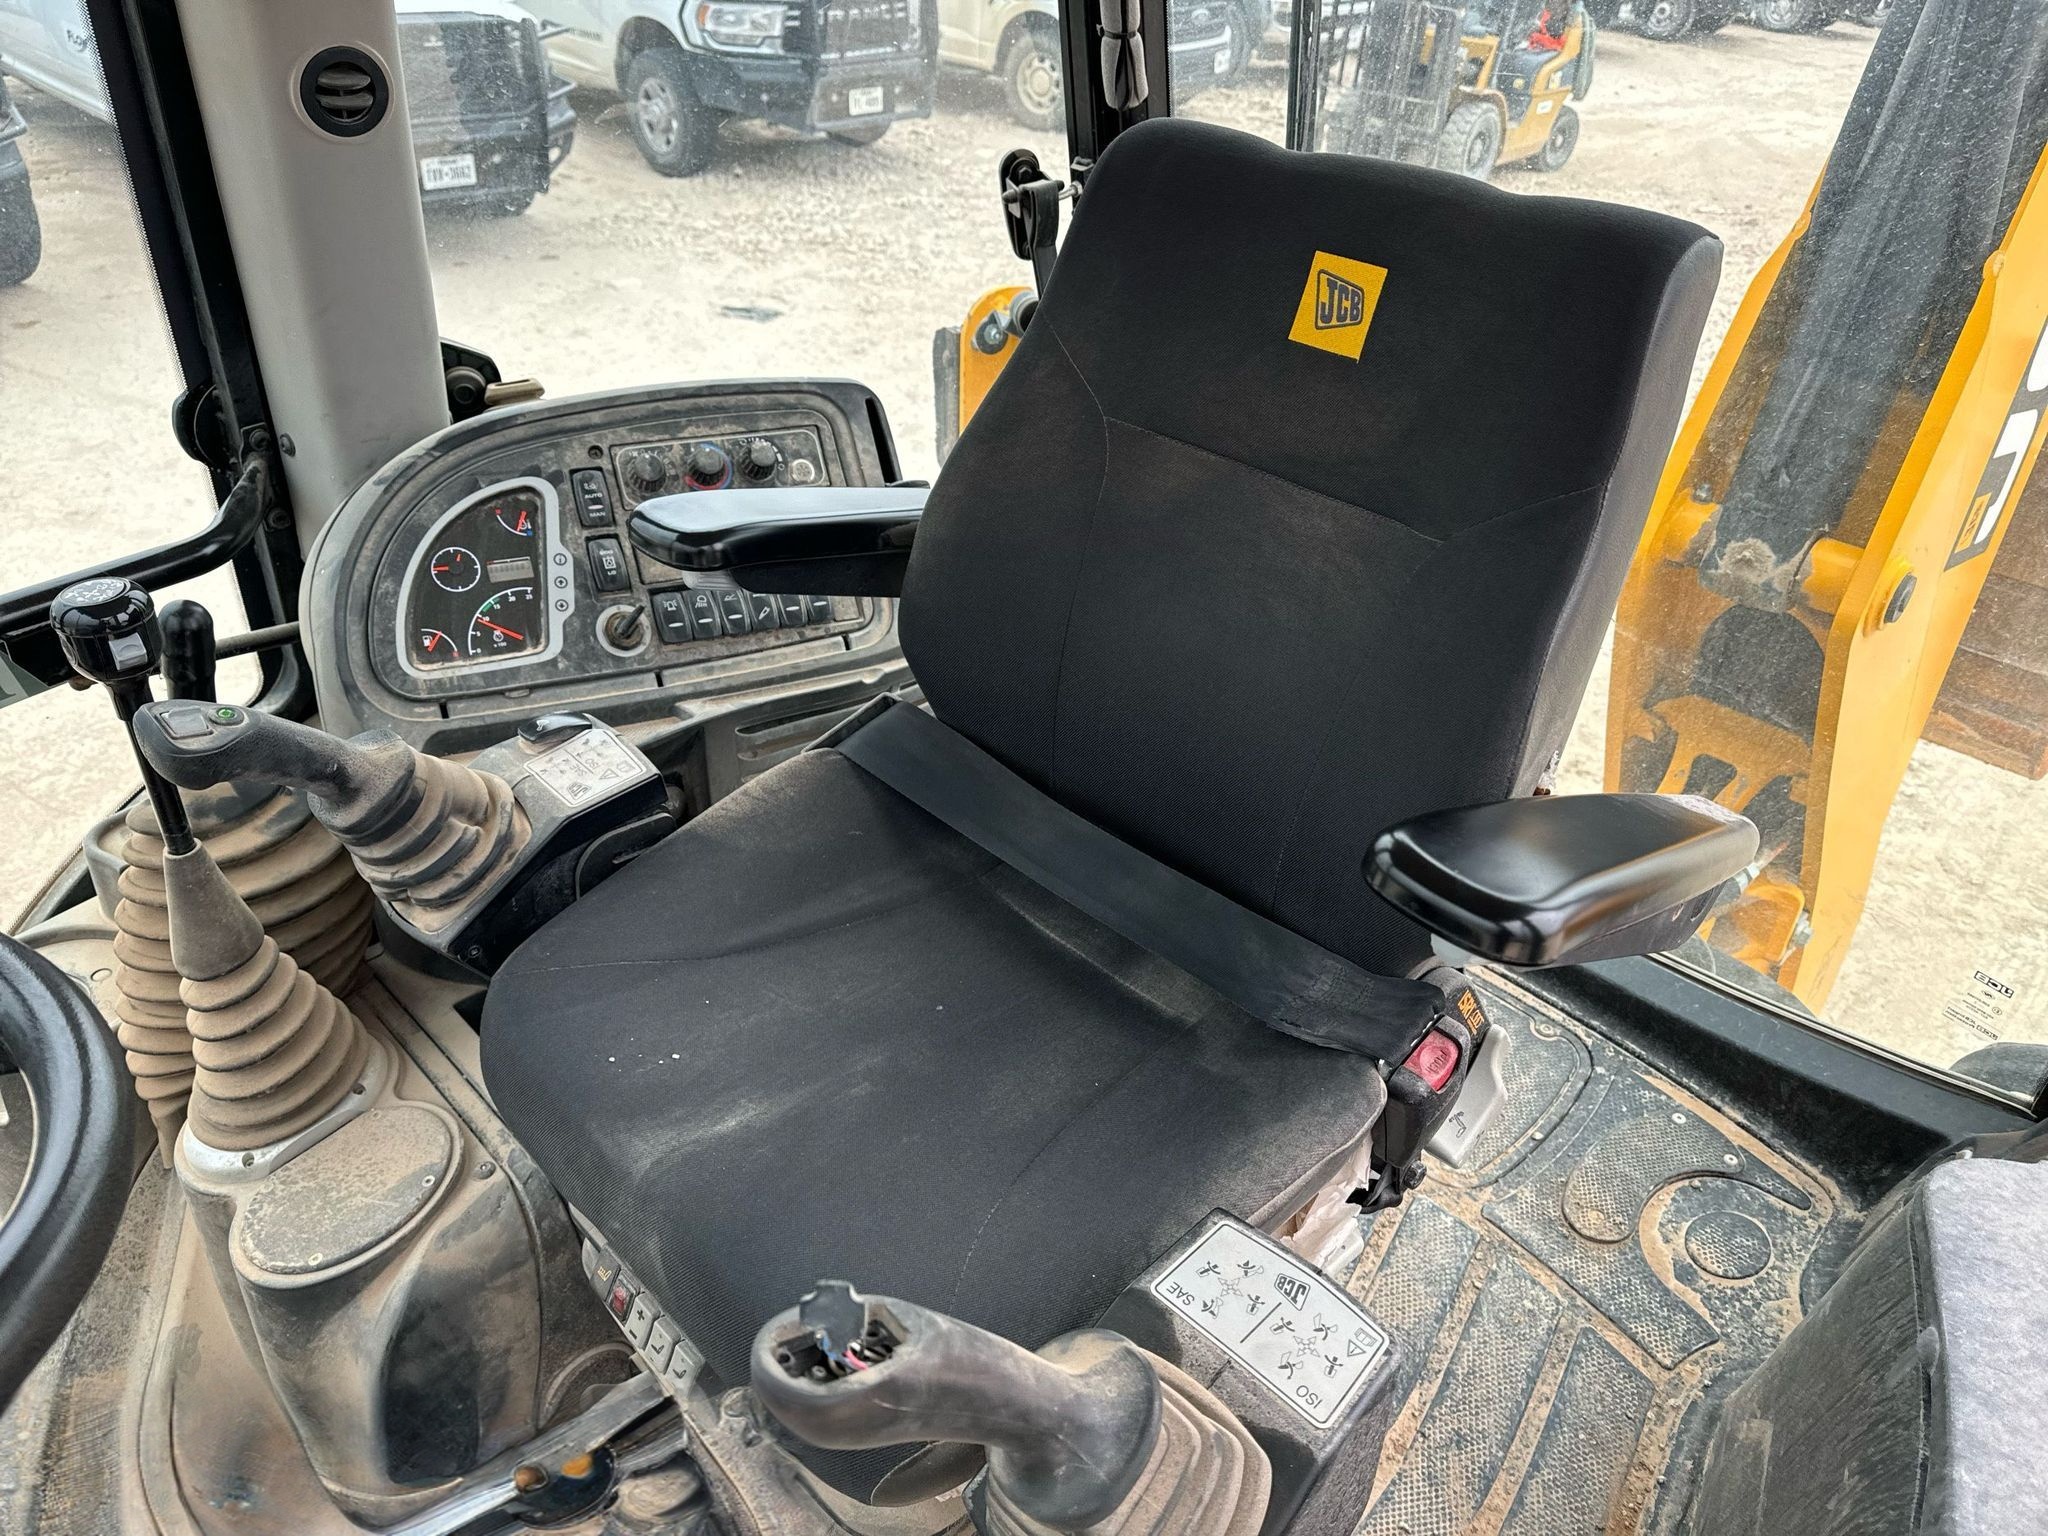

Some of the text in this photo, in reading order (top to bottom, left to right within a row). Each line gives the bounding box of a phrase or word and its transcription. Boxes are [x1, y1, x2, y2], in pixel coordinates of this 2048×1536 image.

[1320, 277, 1362, 324] JCB
[1166, 1281, 1195, 1306] SAE
[1277, 1276, 1307, 1305] JCB
[1296, 1385, 1323, 1409] ISO
